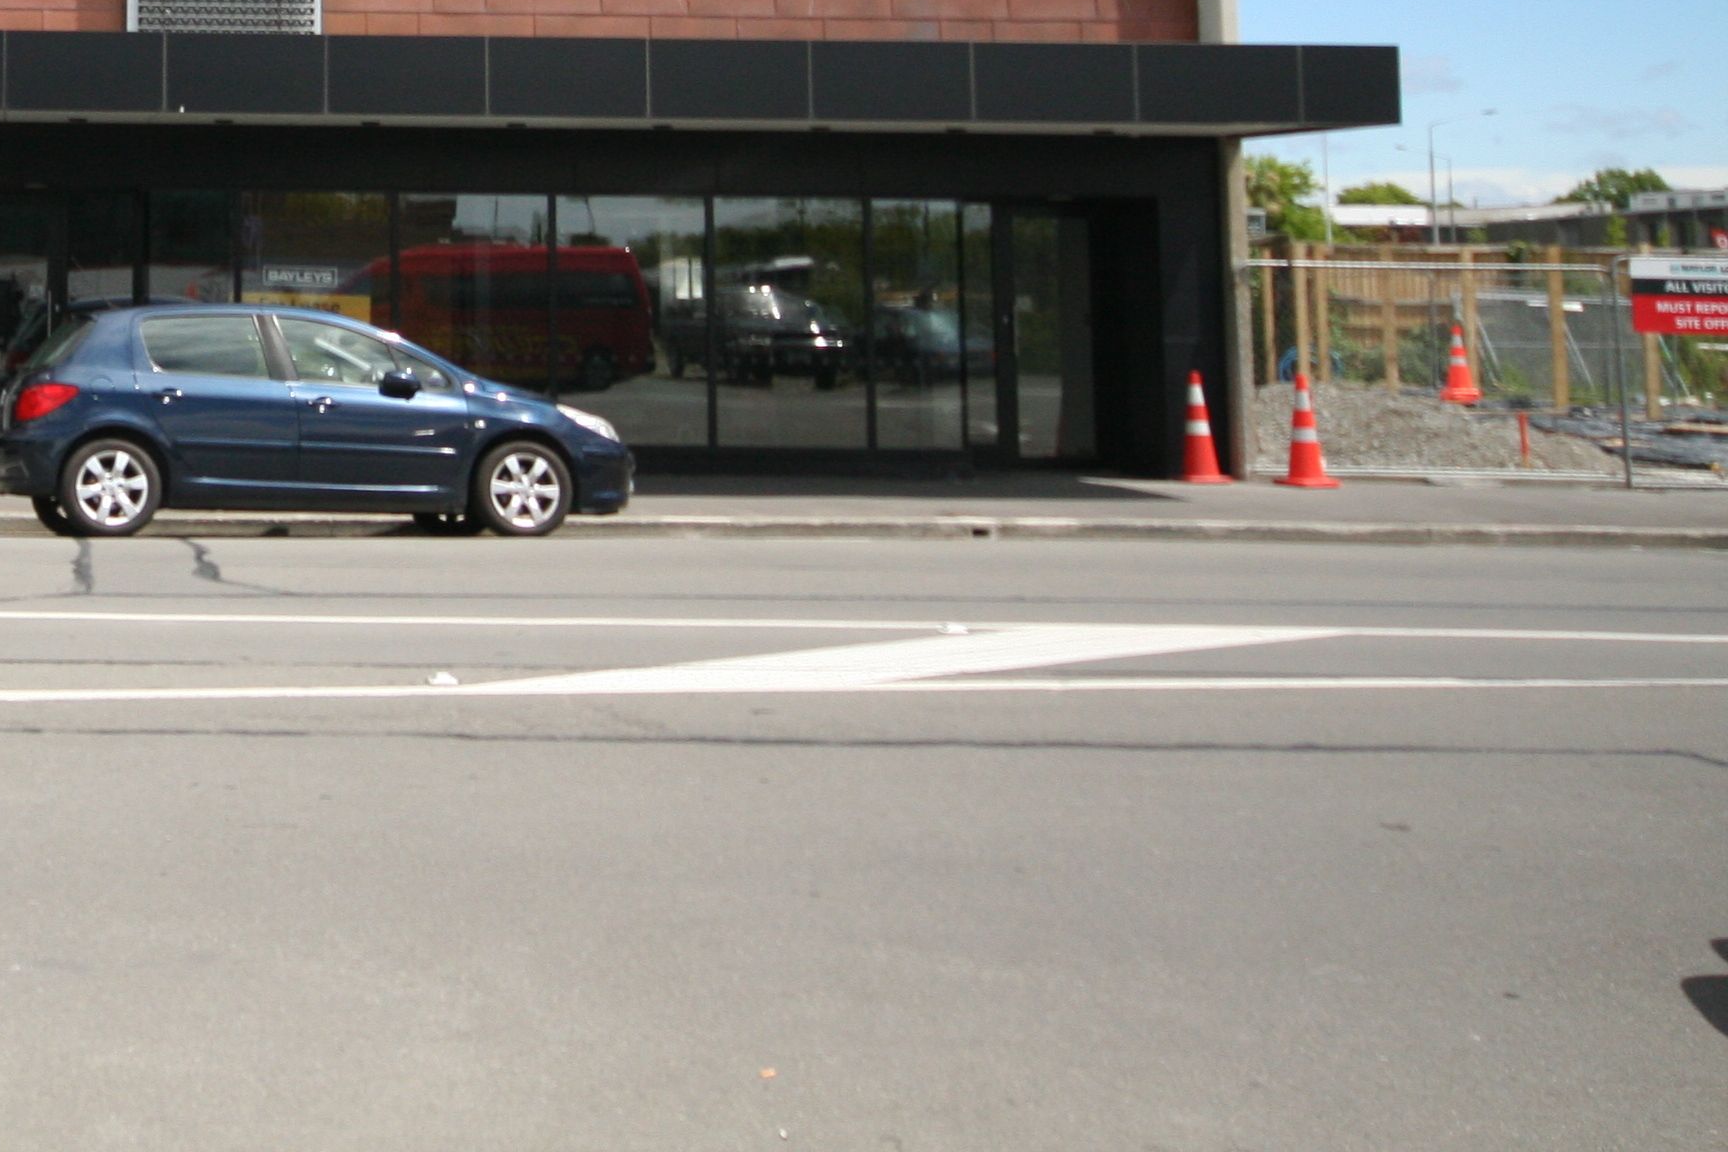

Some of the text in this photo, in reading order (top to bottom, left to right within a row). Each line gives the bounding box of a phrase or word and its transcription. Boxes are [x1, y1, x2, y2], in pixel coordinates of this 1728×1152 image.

[267, 269, 333, 284] BAYLEYS
[1665, 281, 1690, 294] ALL
[1656, 301, 1692, 314] MUST
[1675, 317, 1701, 330] SITE
